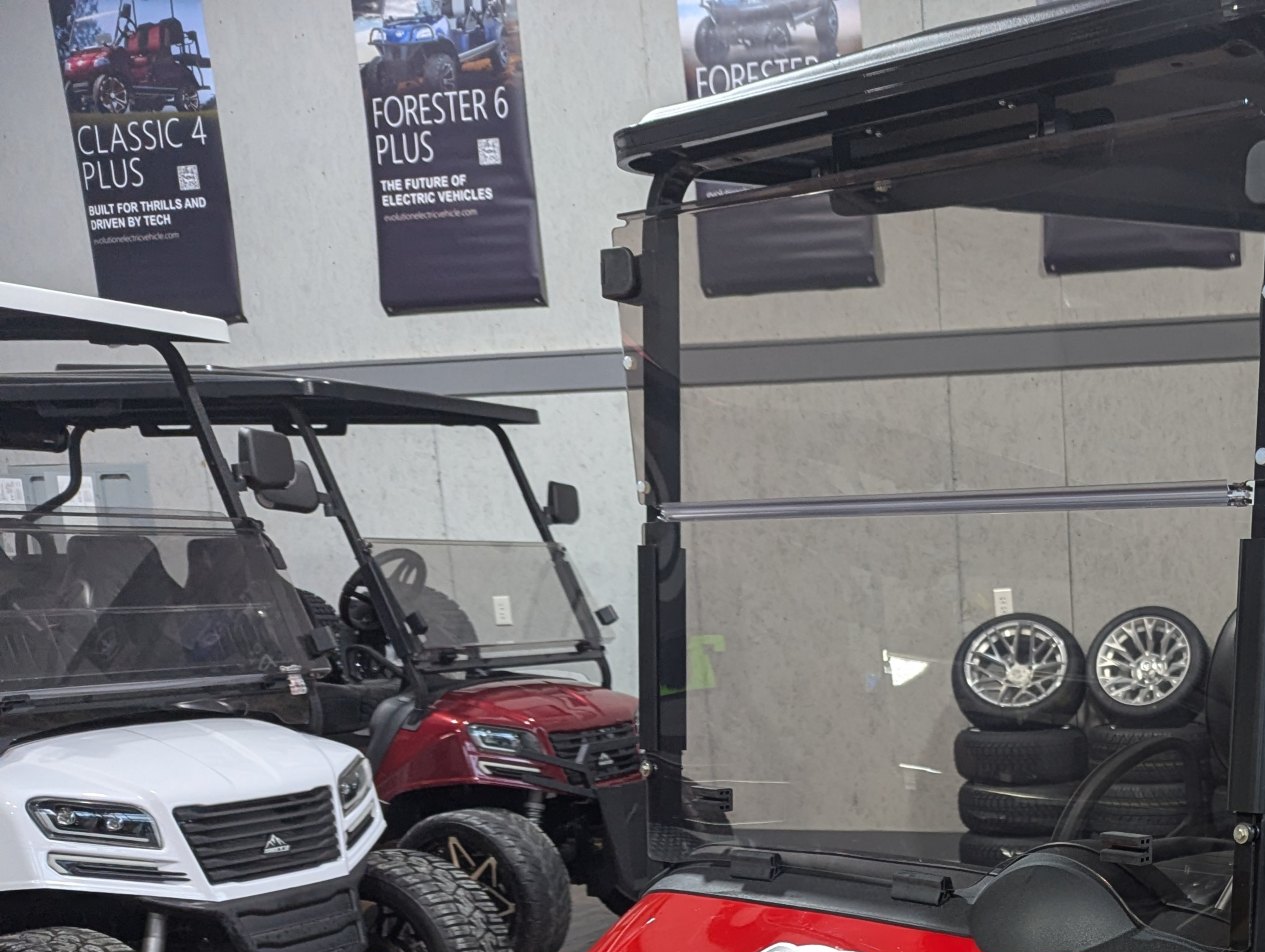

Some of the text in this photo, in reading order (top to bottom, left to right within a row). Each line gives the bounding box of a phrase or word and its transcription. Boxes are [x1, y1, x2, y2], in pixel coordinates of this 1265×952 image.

[372, 86, 509, 128] FORESTER 6
[77, 115, 207, 155] CLASSIC 4
[375, 131, 434, 166] PLUS
[82, 157, 144, 191] PLUS
[380, 174, 467, 192] THE FUTURE OF
[88, 196, 207, 216] BUILT FOR THRILLS AND
[381, 187, 493, 207] ELECTRIC VEHICLES
[90, 213, 171, 231] DRIVEN BY TECH
